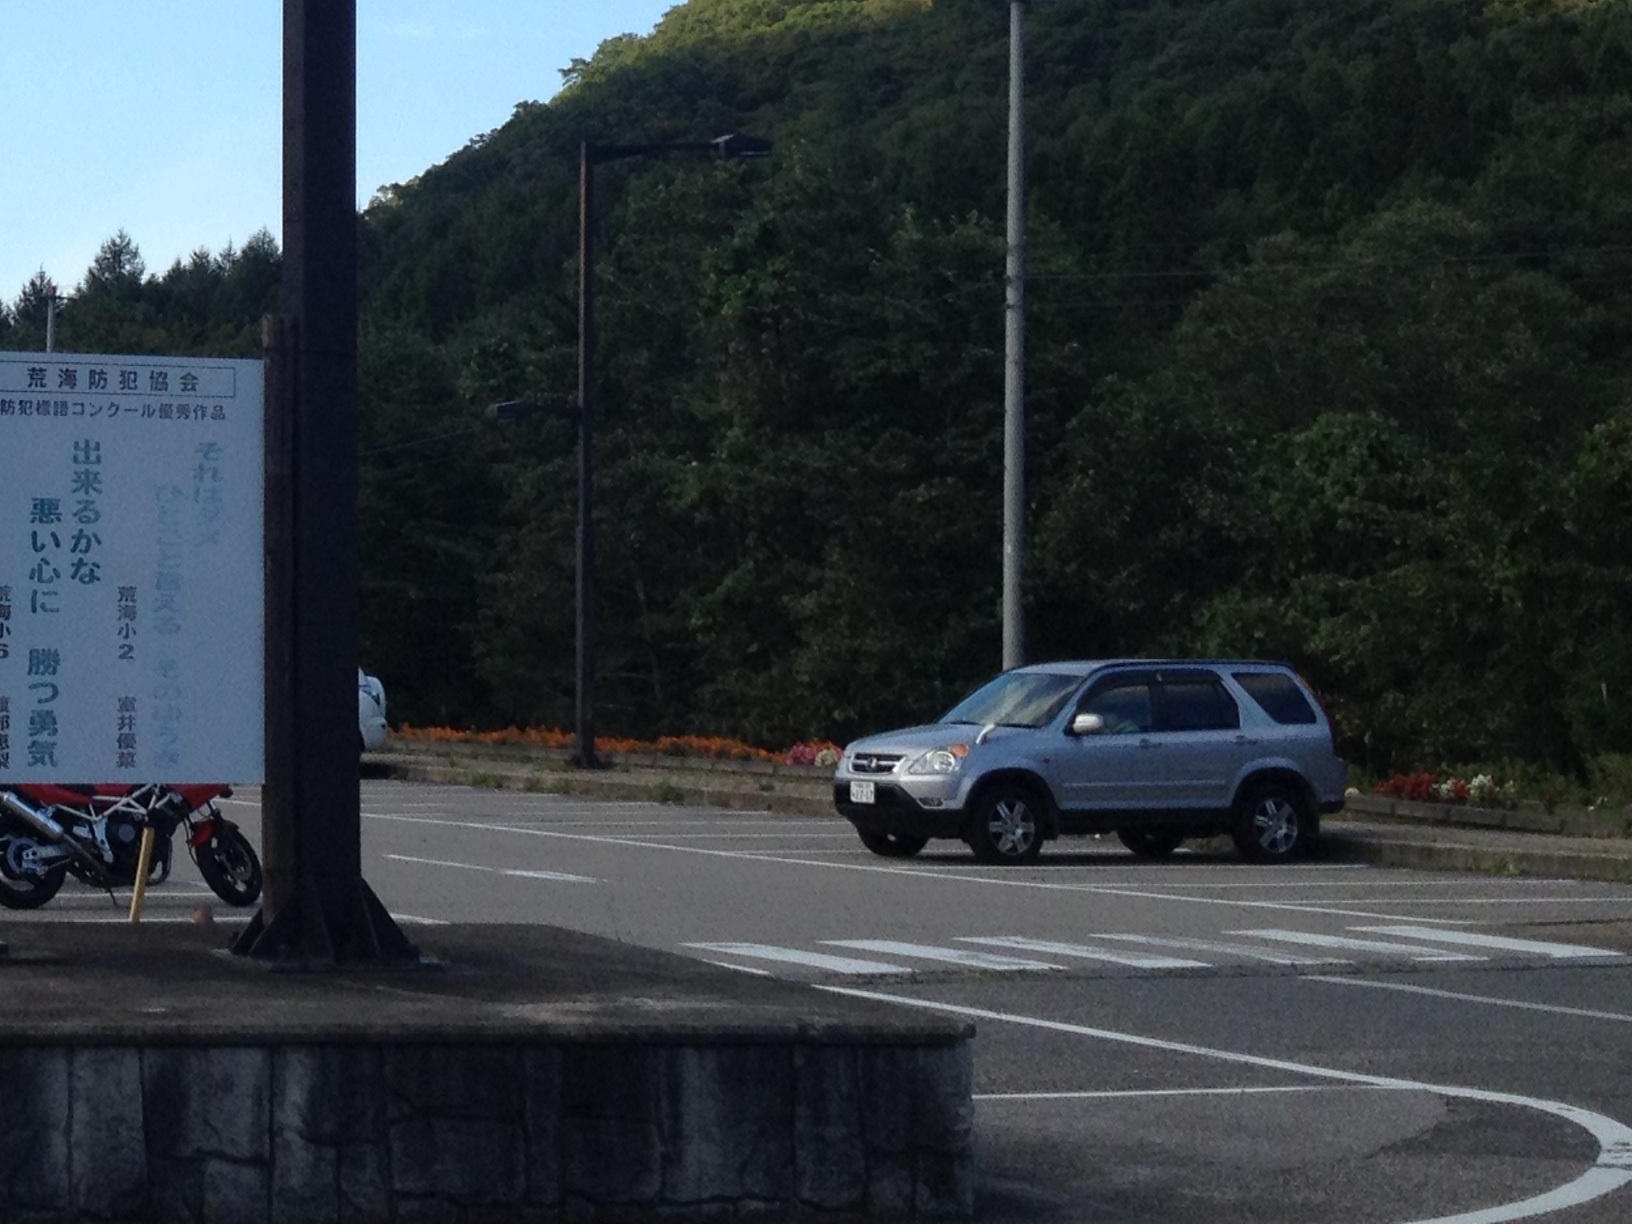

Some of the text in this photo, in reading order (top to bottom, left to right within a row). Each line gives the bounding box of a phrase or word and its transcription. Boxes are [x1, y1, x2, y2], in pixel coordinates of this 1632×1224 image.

[0, 398, 227, 422] 防犯標語コンクール優秀作品
[26, 366, 200, 393] 荒海防犯協会
[70, 438, 103, 585] 出来るかな
[27, 497, 63, 767] 悪い心に 勝つ勇気
[117, 586, 137, 660] 荒海小2
